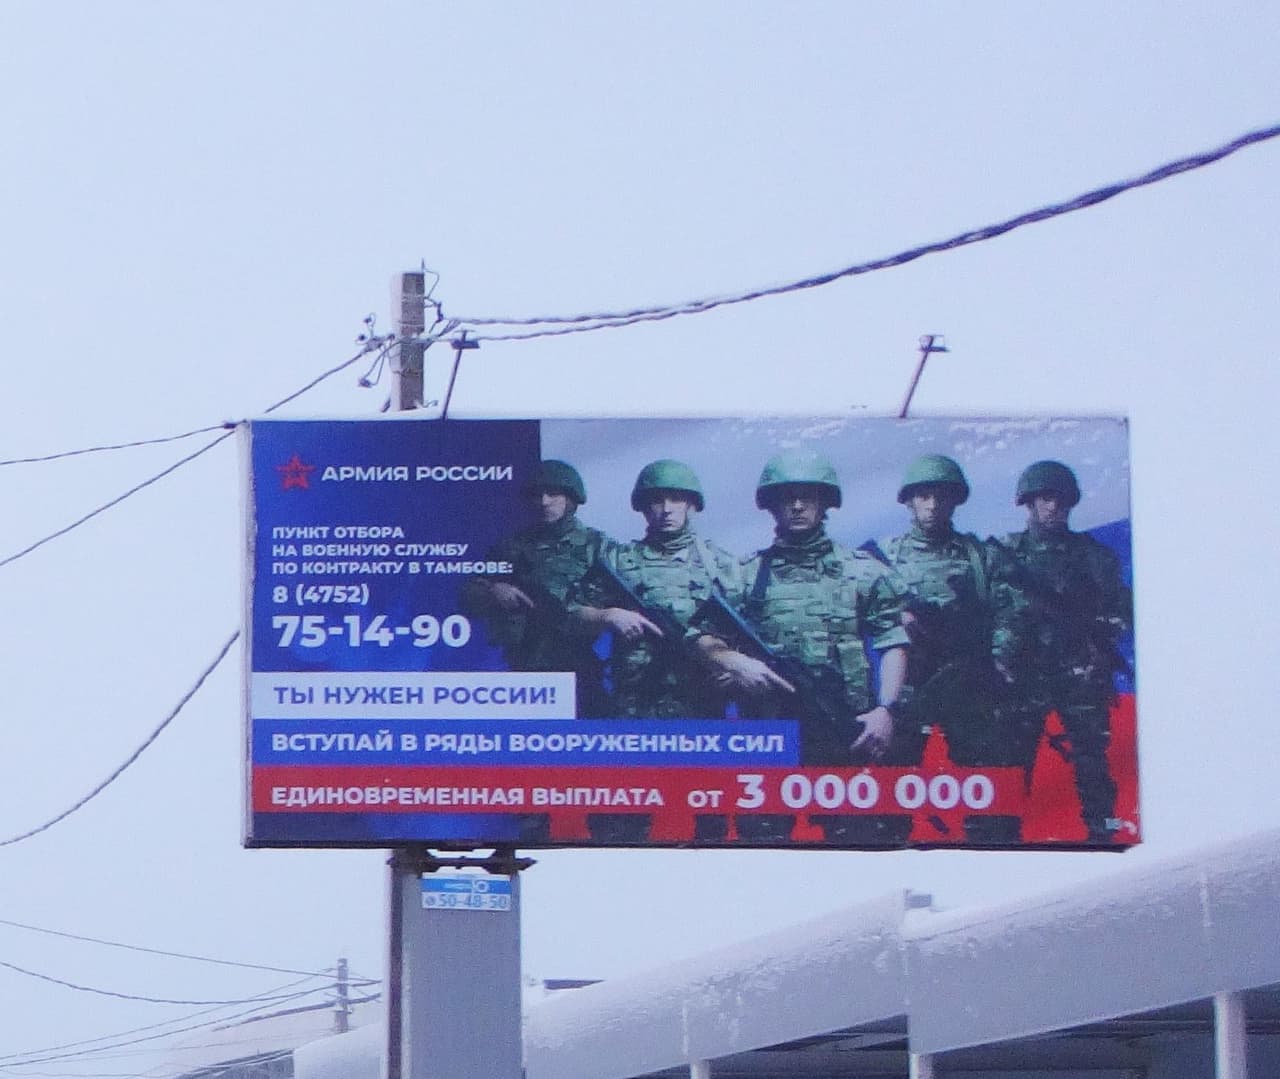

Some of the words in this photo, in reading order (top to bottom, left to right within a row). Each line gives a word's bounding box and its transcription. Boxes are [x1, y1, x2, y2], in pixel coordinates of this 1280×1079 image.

[320, 465, 410, 482] АРМИЯ
[415, 465, 514, 482] РОССИИ
[271, 525, 330, 540] ПУНКТ
[333, 525, 406, 540] ОТБОРА
[271, 543, 299, 558] НА
[301, 543, 392, 558] ВОЕННУЮ
[393, 543, 469, 558] СЛУЖБУ
[271, 561, 299, 576] ПО
[301, 561, 405, 576] КОНТРАКТУ
[407, 561, 422, 575] В
[423, 561, 514, 575] ТАМБОВЕ:
[271, 584, 290, 605] 8
[294, 583, 371, 606] (4752)
[271, 613, 472, 649] 75-14-90
[272, 686, 315, 706] ТЫ
[323, 686, 424, 706] НУЖЕН
[433, 686, 557, 706] РОССИИ!
[270, 729, 394, 752] ВСТУПАЙ
[400, 733, 418, 752] В
[424, 733, 502, 755] РЯДЫ
[508, 733, 721, 753] ВООРУЖЕННЫХ
[726, 734, 785, 753] СИЛ
[270, 785, 525, 807] ЕДИНОВРЕМЕННАЯ
[531, 787, 665, 807] ВЫПЛАТА
[735, 774, 767, 809] 3
[780, 772, 881, 810] 000
[894, 773, 996, 810] 000
